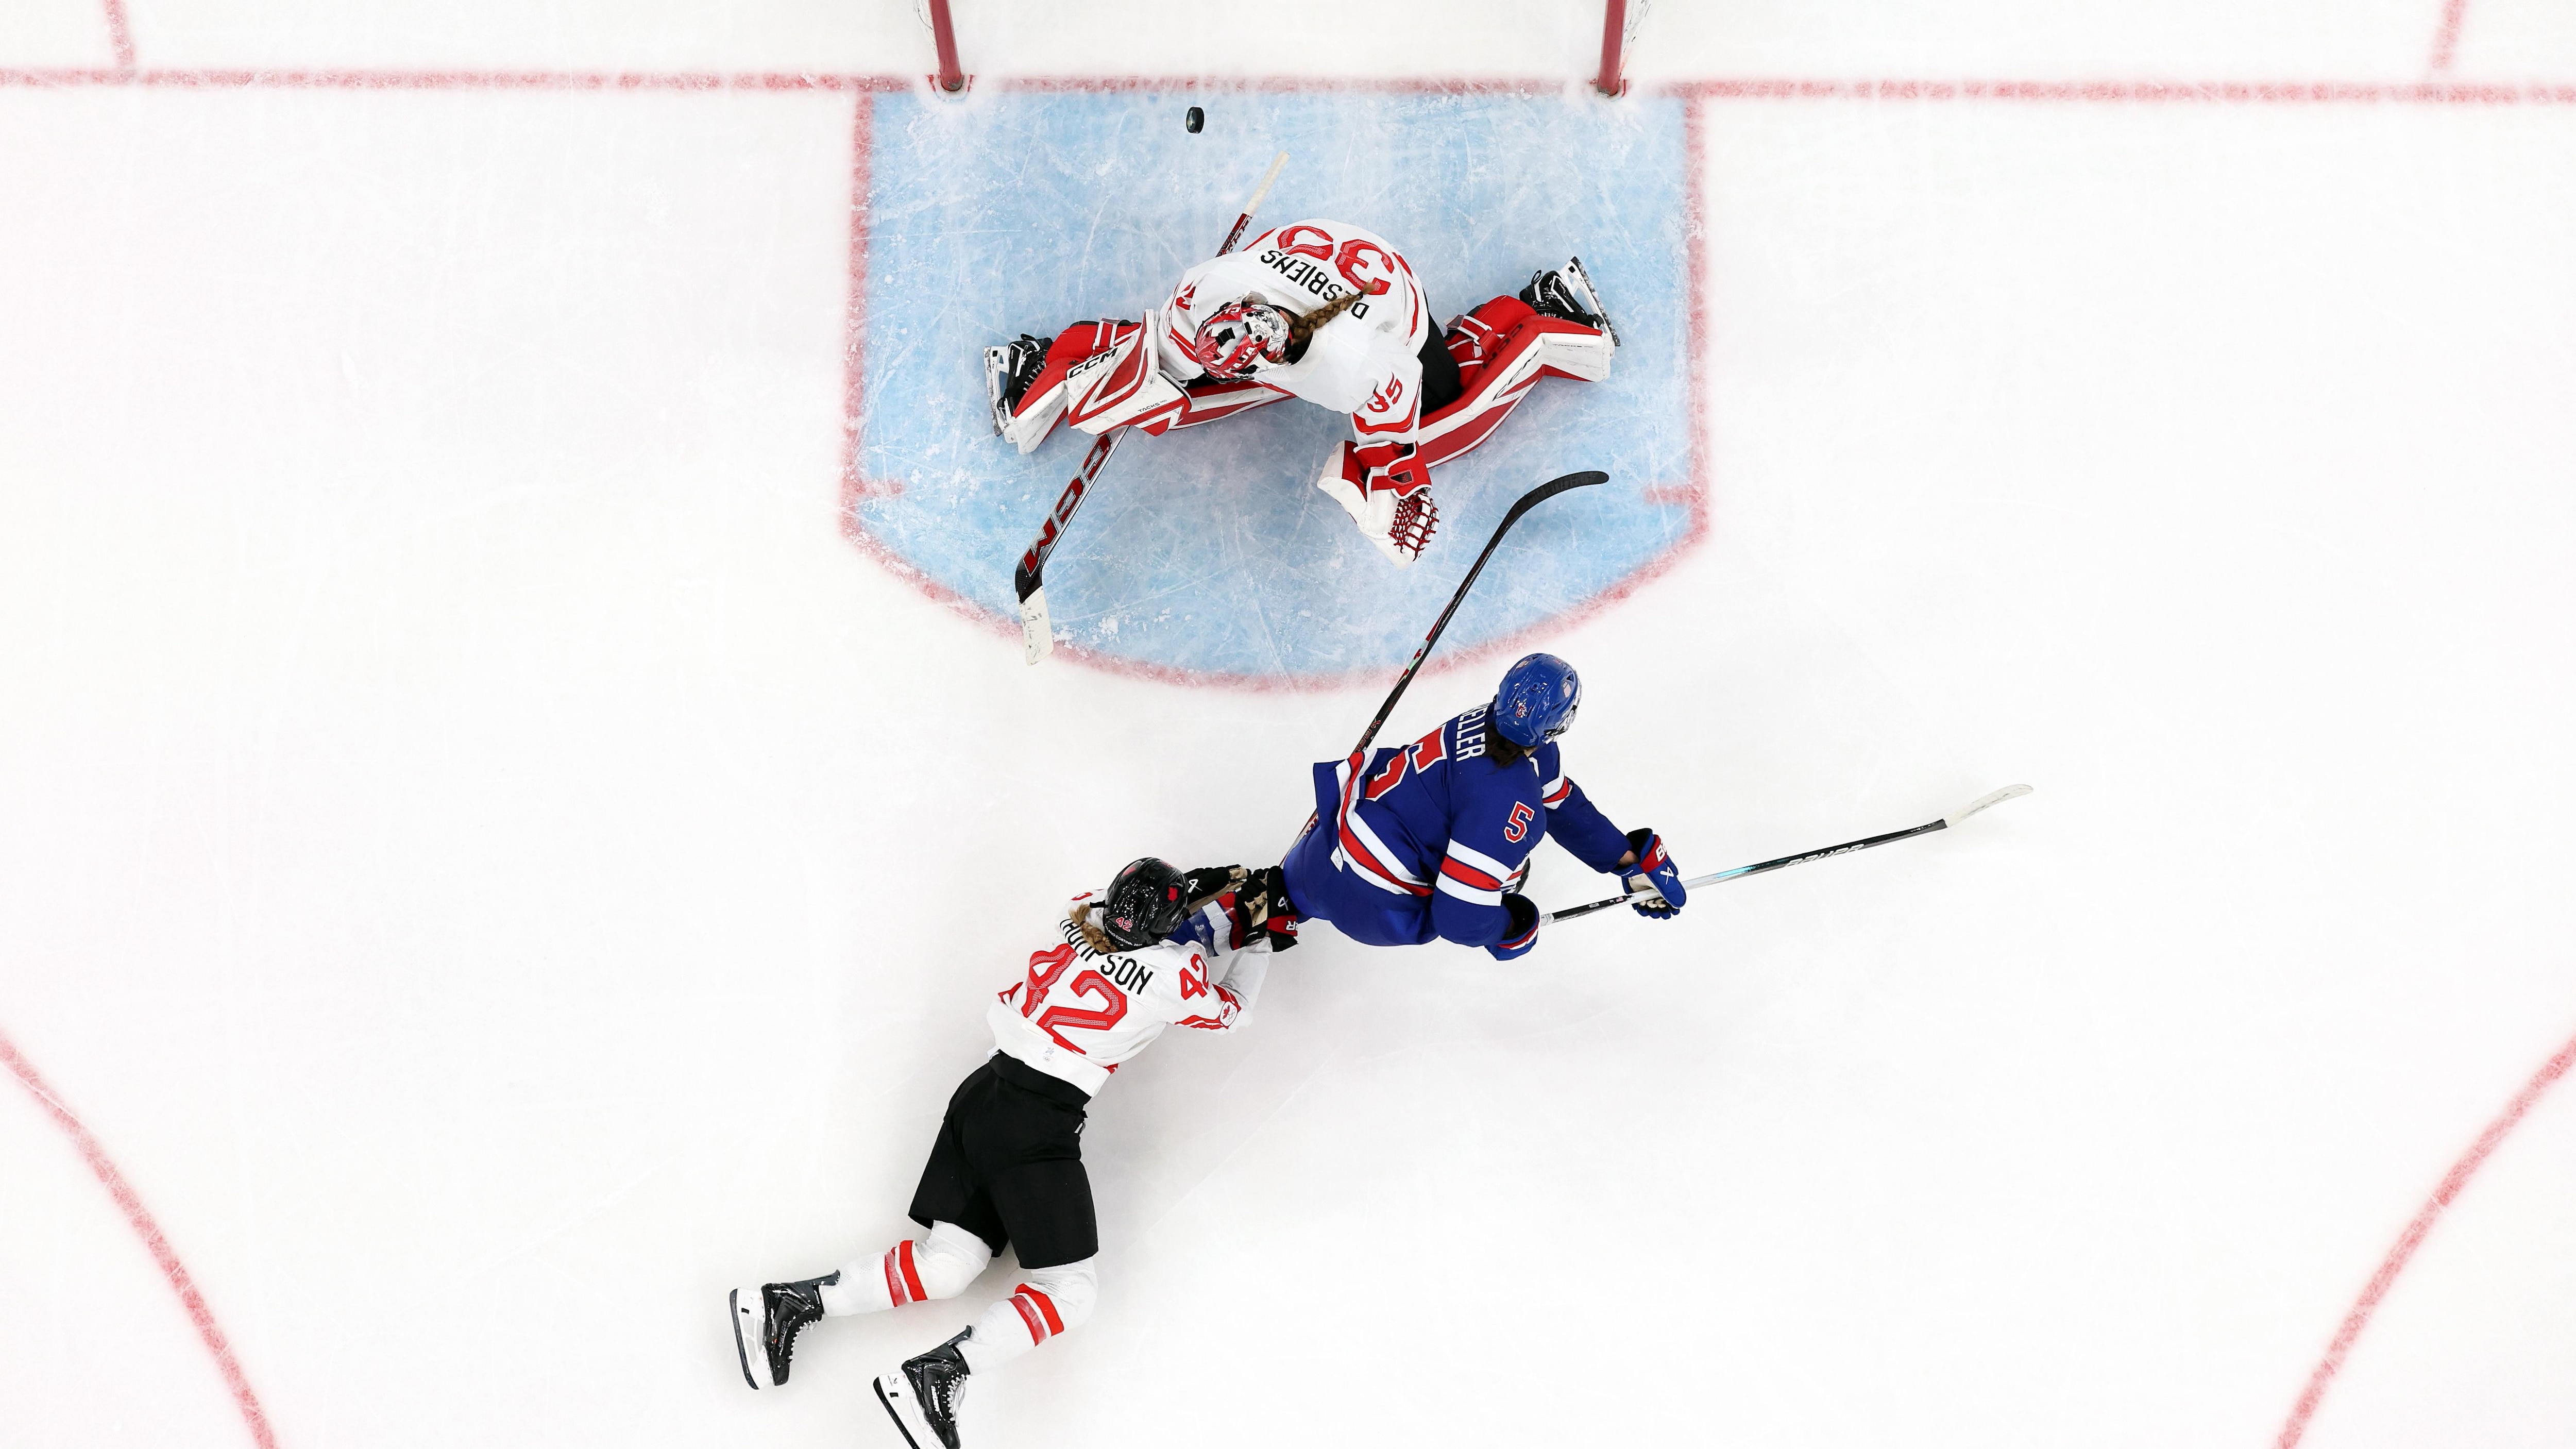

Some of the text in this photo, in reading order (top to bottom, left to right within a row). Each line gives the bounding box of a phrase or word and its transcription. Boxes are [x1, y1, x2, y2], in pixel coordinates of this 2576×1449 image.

[1278, 226, 1394, 295] 35
[1261, 250, 1369, 319] DSBIENS
[1069, 347, 1118, 379] CCM
[1138, 402, 1160, 413] TACKS
[1367, 371, 1403, 413] 35
[1022, 432, 1113, 578] CCM
[1363, 722, 1448, 801] 5
[1504, 801, 1535, 844] 5
[1115, 917, 1133, 932] 42
[1021, 943, 1127, 1031] 42
[1179, 953, 1209, 1000] 42
